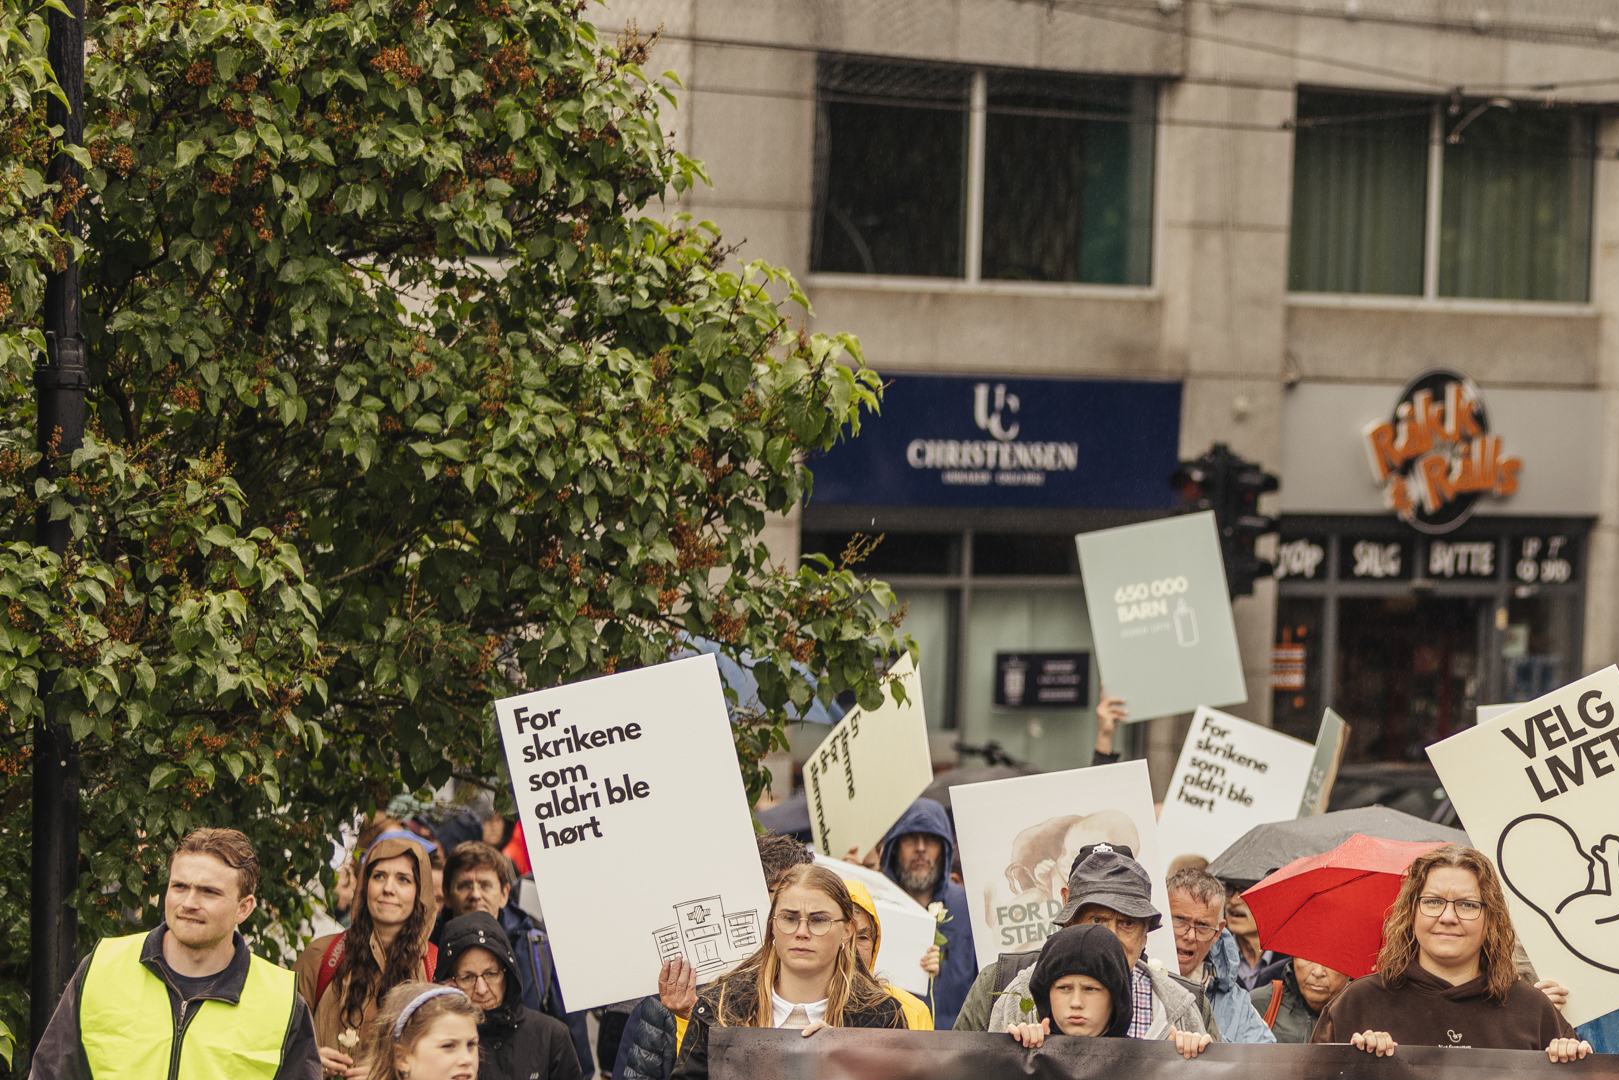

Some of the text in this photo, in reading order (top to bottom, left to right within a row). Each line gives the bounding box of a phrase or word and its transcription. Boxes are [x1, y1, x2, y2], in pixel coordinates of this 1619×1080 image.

[906, 438, 1078, 471] CHRISTENSEN
[1273, 538, 1324, 579] JØP
[1114, 575, 1189, 604] 650 000
[1117, 599, 1168, 623] BARN
[513, 706, 561, 735] For
[851, 709, 862, 740] En
[1201, 716, 1232, 740] For
[1500, 690, 1615, 759] VELG
[522, 722, 642, 763] skrikene
[830, 733, 840, 764] for
[1195, 735, 1269, 774] skrikene
[820, 748, 831, 775] de
[840, 725, 856, 801] stemme
[1188, 755, 1227, 778] som
[528, 764, 588, 792] som
[1183, 771, 1254, 808] aldri ble
[534, 773, 650, 820] aldri ble
[538, 816, 603, 850] hørt
[996, 901, 1043, 926] FOR
